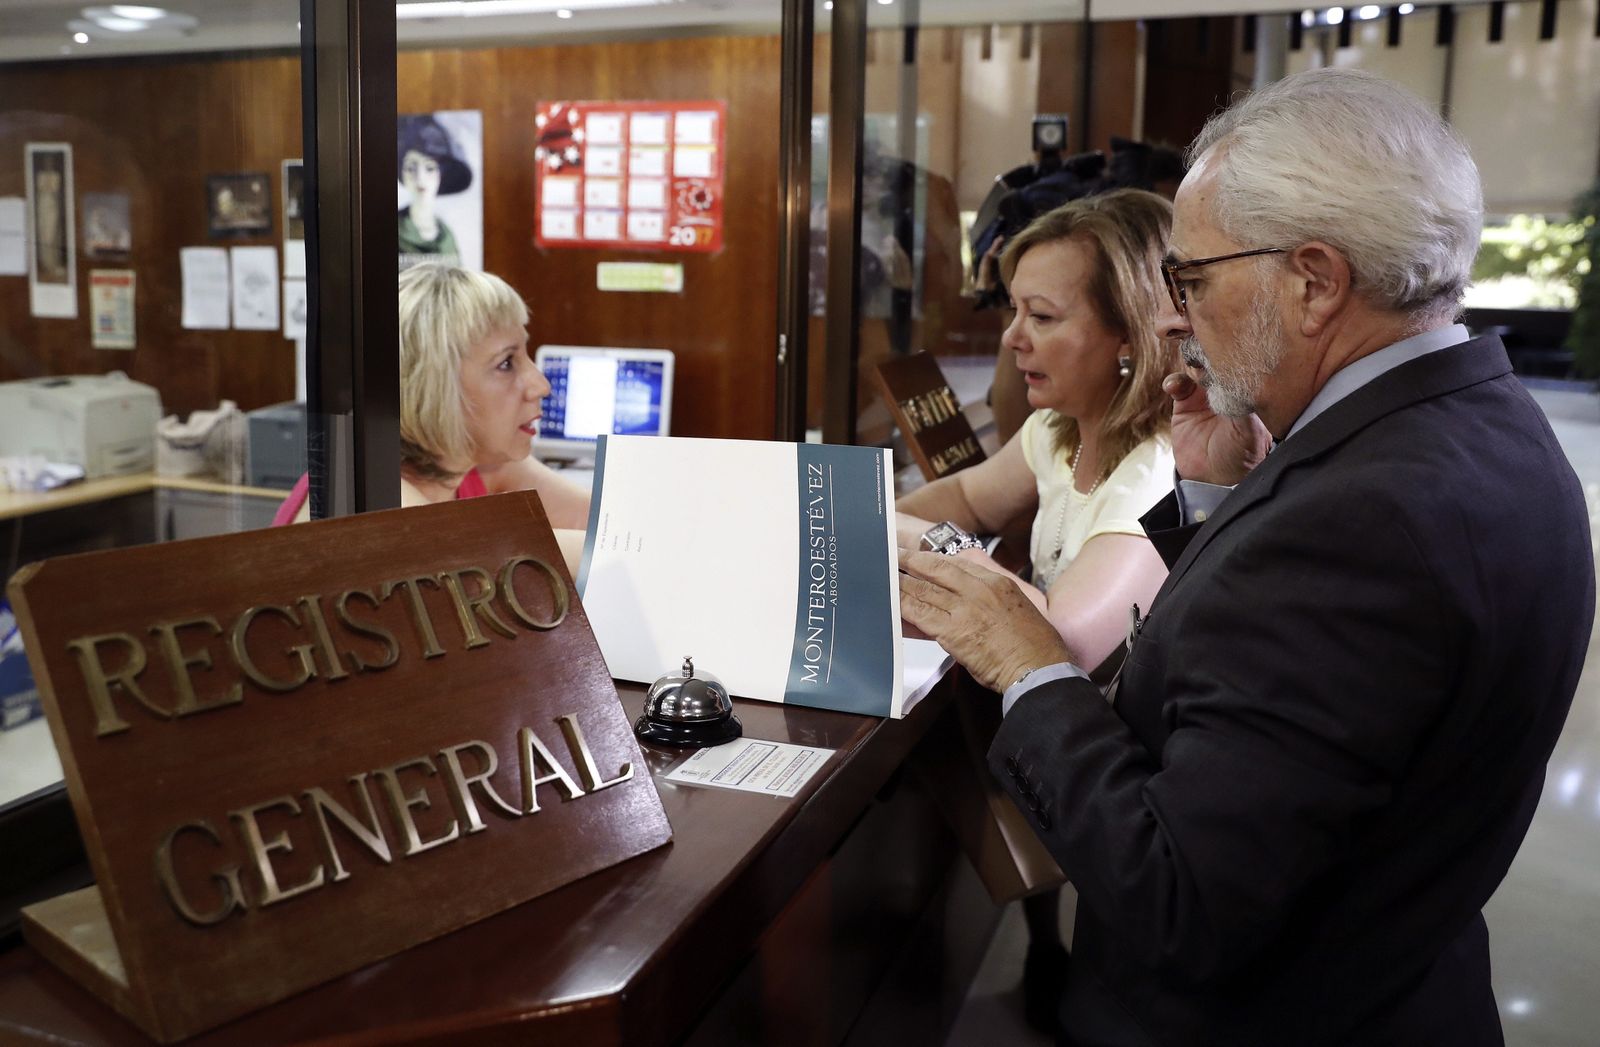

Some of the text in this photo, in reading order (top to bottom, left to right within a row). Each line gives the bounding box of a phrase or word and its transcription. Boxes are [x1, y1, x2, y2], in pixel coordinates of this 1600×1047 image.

[66, 554, 571, 737] REGISTRO
[801, 463, 825, 684] MONTEROESTÉVEZ
[830, 536, 838, 606] ABOGADOS
[152, 712, 635, 928] GENERAL
